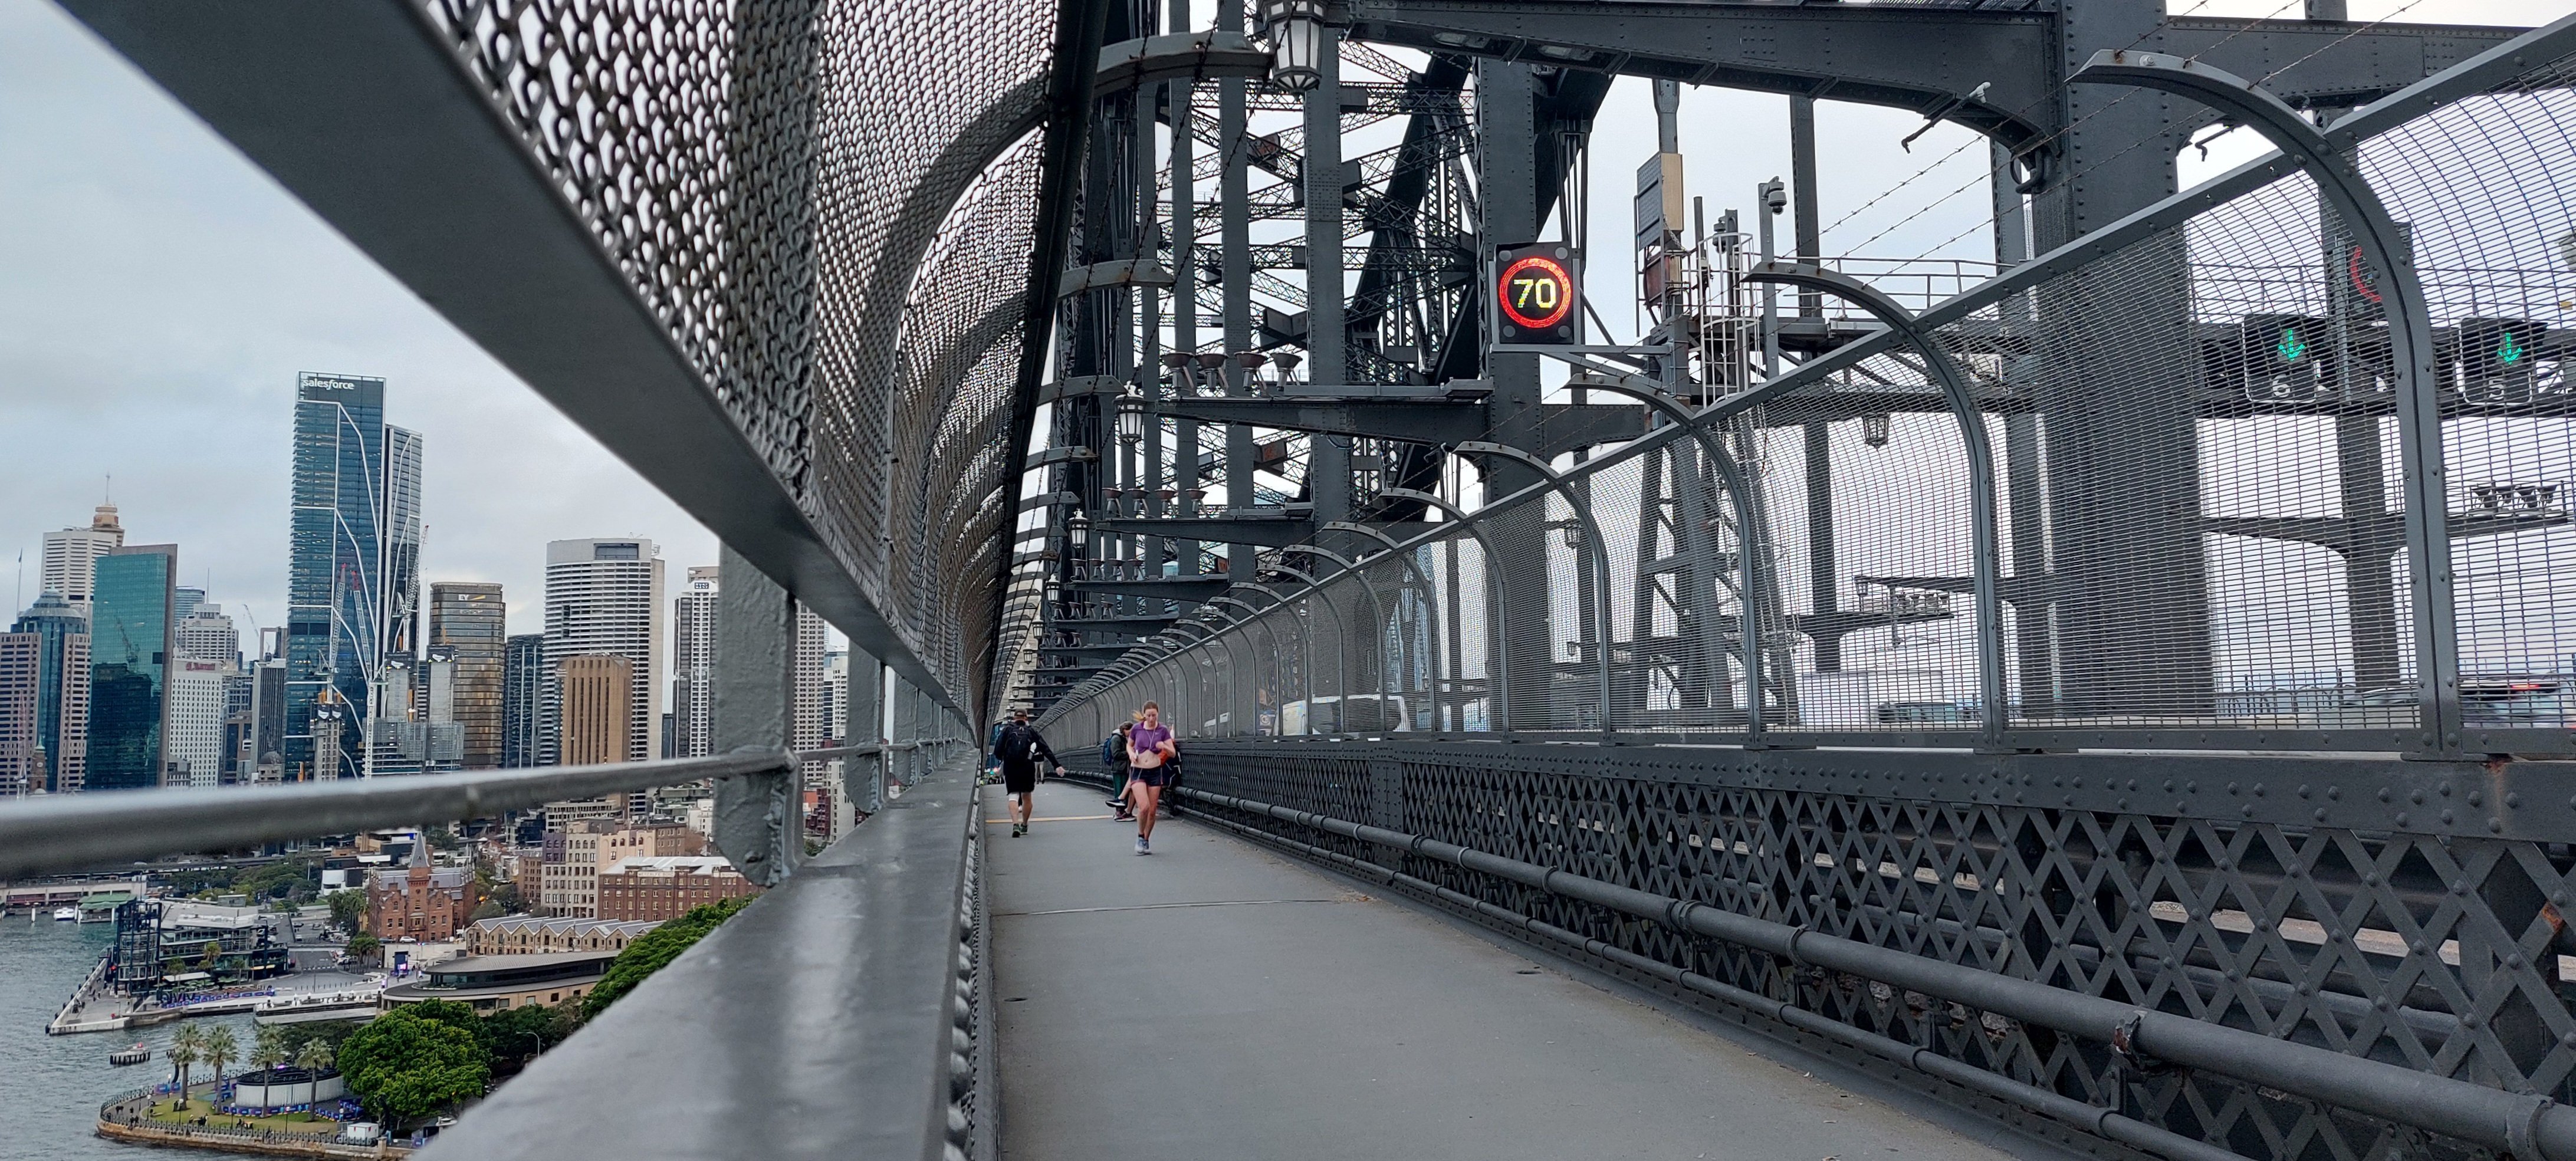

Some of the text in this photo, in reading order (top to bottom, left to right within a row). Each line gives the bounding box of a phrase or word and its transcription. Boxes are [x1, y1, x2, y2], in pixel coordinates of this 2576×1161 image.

[1513, 278, 1556, 308] 70
[302, 378, 354, 390] salesforce
[2272, 373, 2291, 398] 6
[2489, 376, 2505, 400] 5
